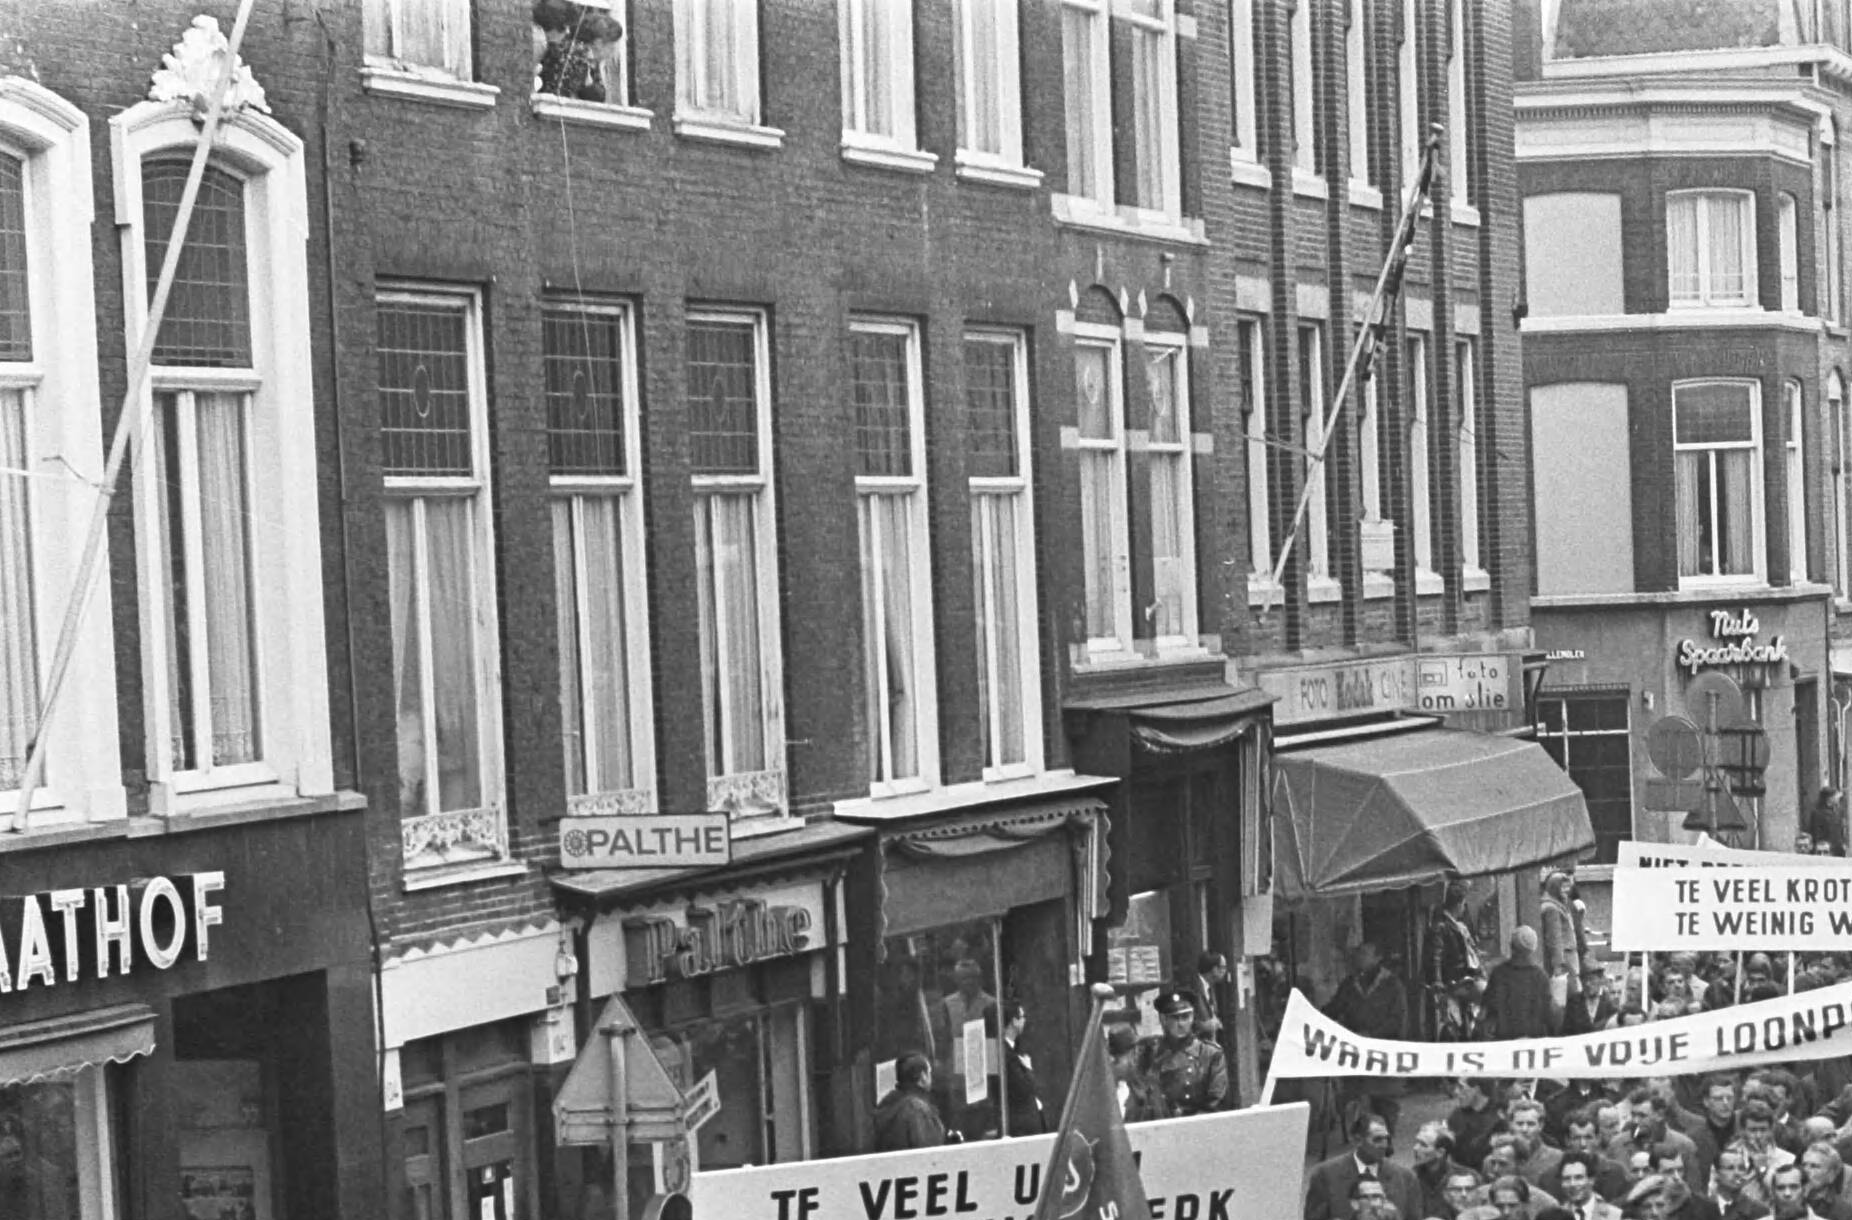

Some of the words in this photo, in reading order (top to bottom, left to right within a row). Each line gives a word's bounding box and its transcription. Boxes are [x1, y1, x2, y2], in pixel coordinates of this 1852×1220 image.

[1709, 608, 1760, 638] Nuts
[1457, 657, 1498, 679] foto
[1680, 636, 1789, 675] Spaarbank
[587, 827, 724, 856] PALTHE
[1675, 880, 1699, 903] TE
[1713, 879, 1776, 903] VEEL
[1675, 912, 1699, 935] TE
[1712, 911, 1814, 936] WEINIG
[622, 898, 812, 986] Palthe
[1446, 1051, 1485, 1071] IS
